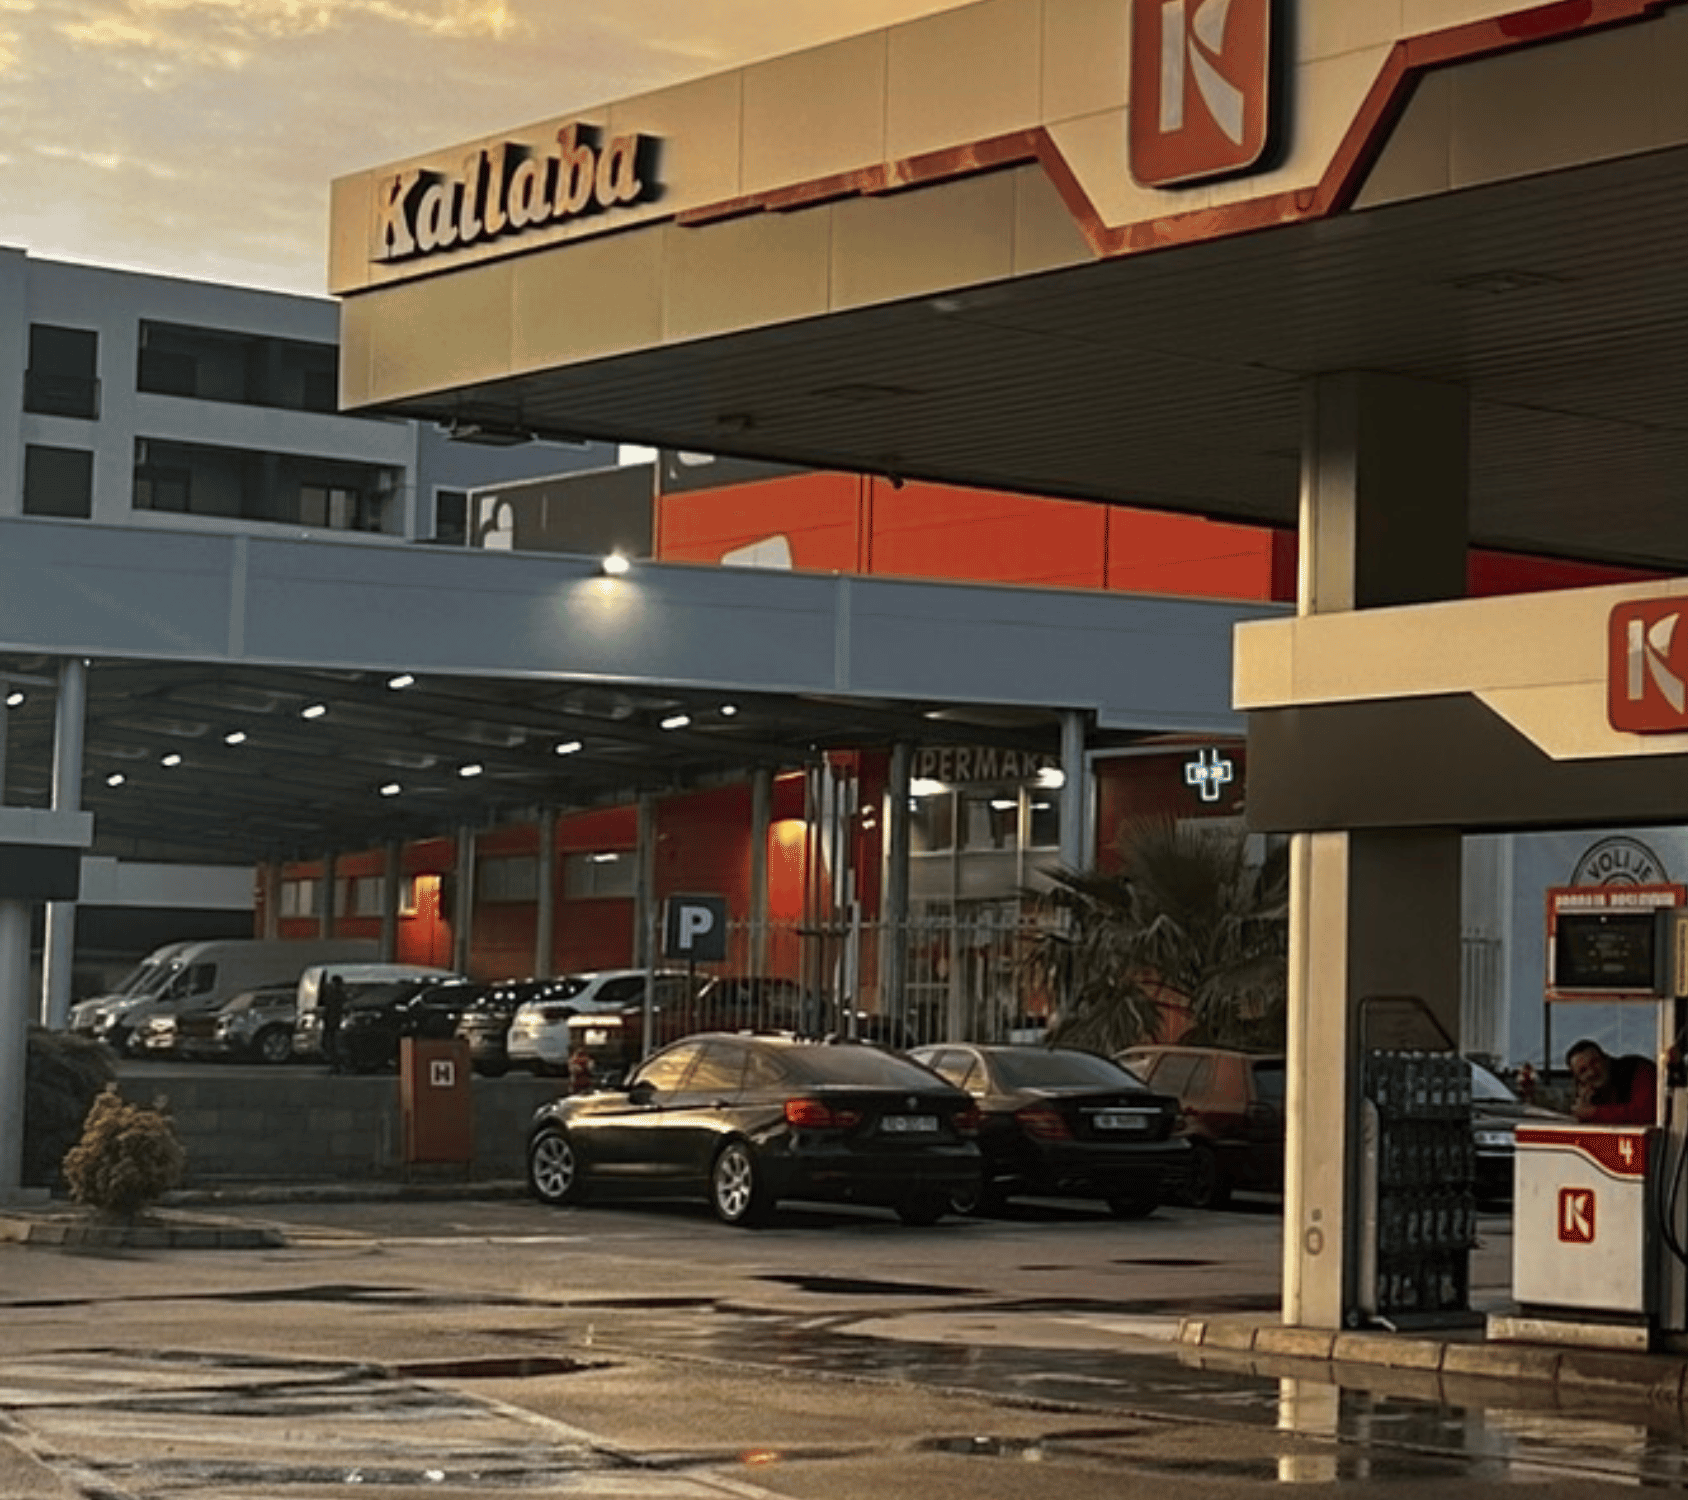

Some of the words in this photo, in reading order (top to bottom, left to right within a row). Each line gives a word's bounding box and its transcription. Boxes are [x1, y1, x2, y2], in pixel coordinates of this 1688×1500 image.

[370, 121, 652, 260] Kallaba
[679, 905, 714, 949] P
[1617, 1136, 1633, 1166] 4
